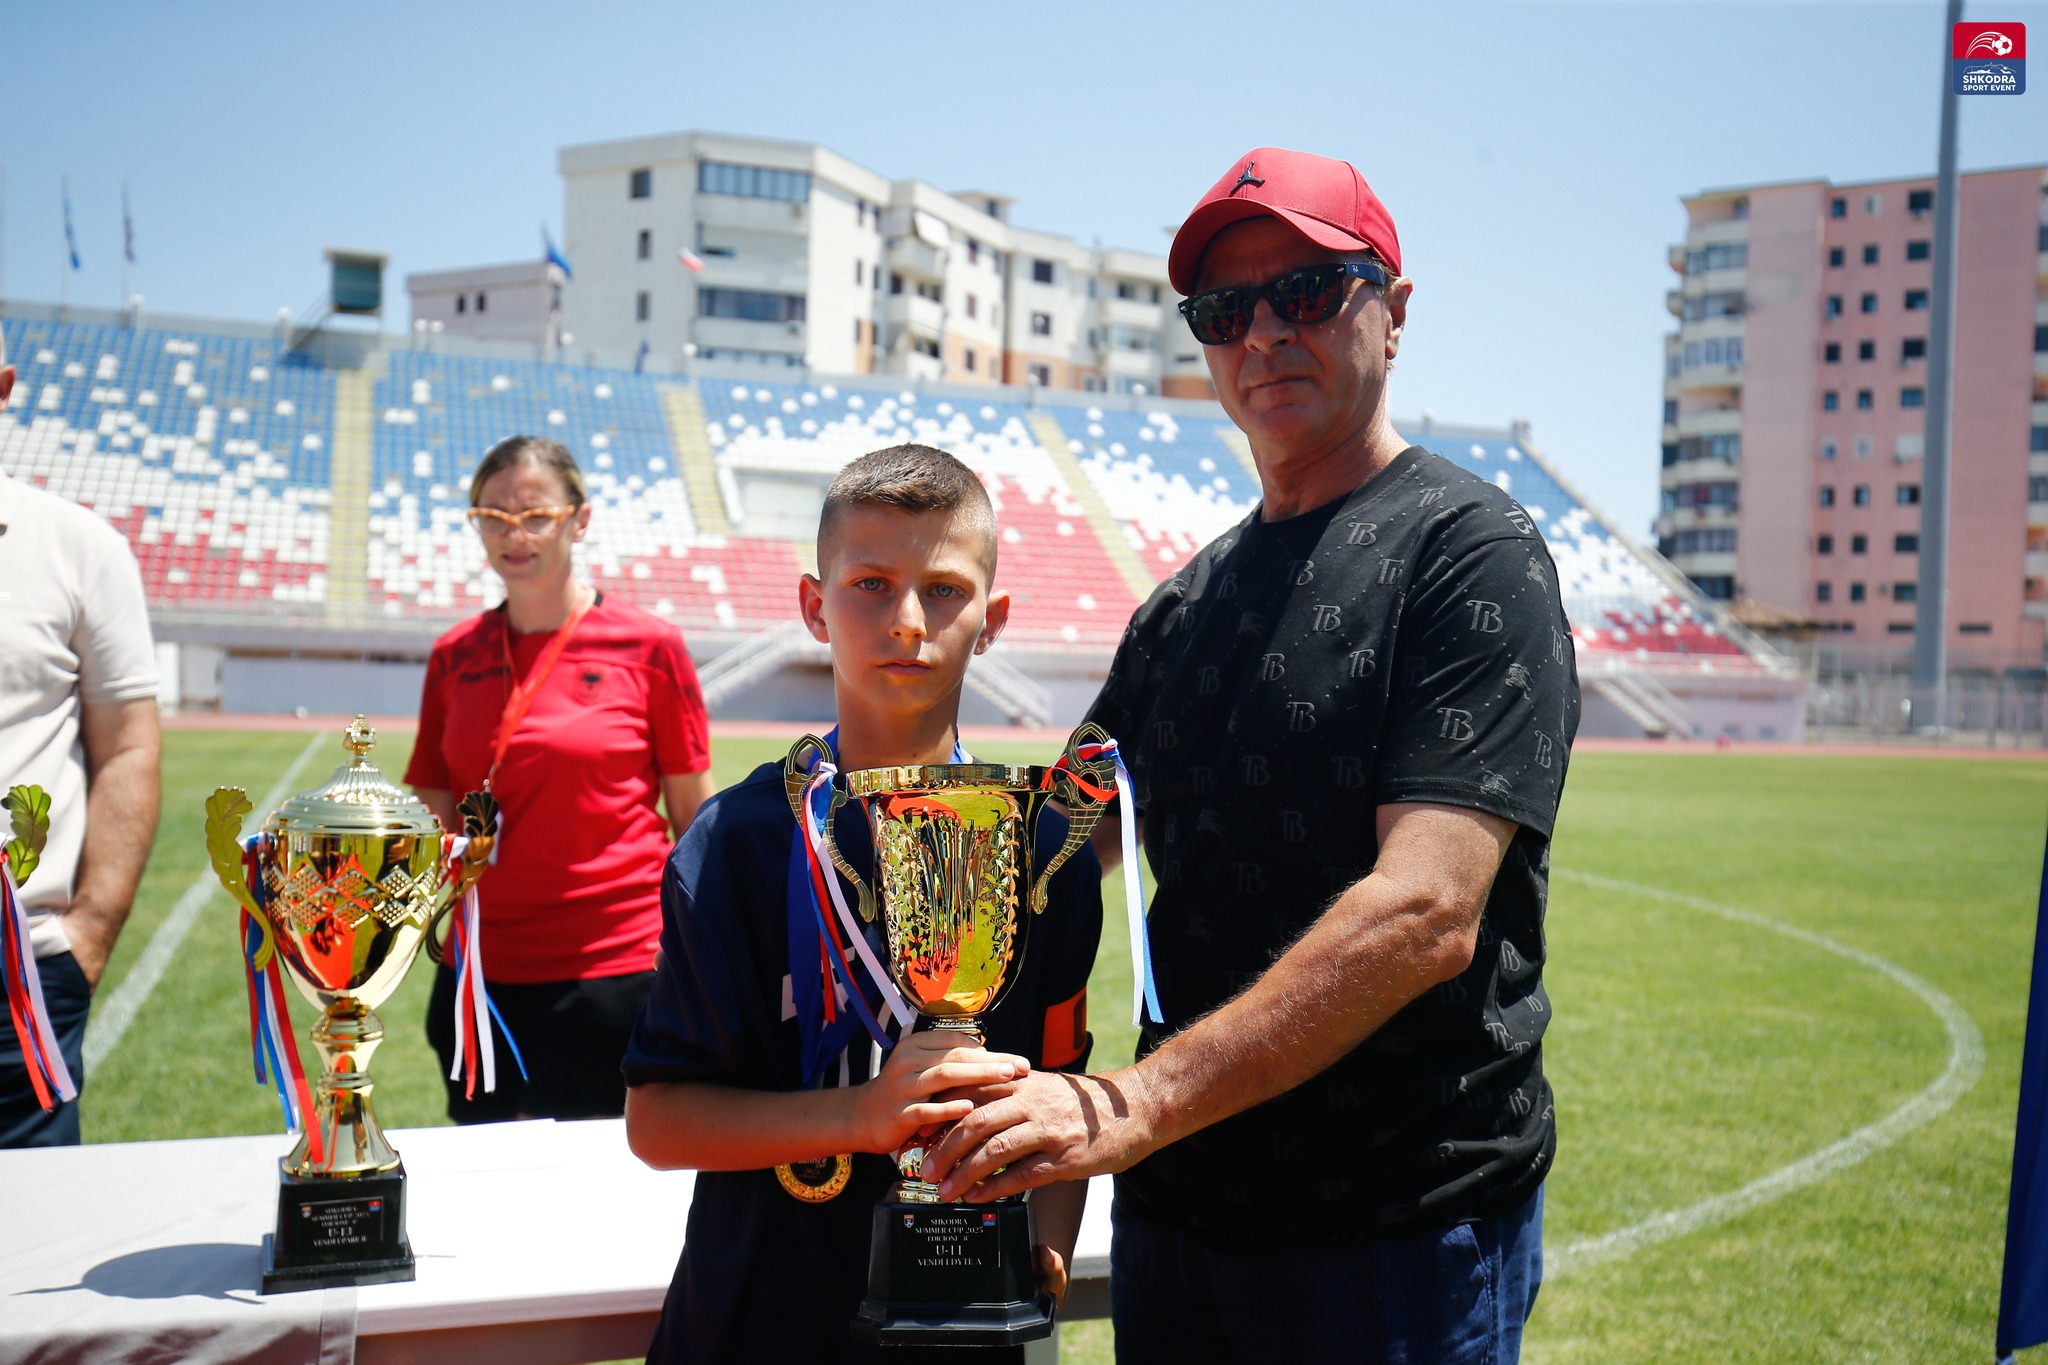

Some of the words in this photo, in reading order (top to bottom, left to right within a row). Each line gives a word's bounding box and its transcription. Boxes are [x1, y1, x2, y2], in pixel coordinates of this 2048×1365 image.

[1346, 521, 1377, 547] TB
[1504, 503, 1534, 536] TB
[1286, 559, 1314, 587] TB
[1311, 604, 1341, 633] TB
[1466, 599, 1504, 635] TB
[1259, 652, 1286, 681] TB
[1348, 648, 1377, 679] TB
[1286, 701, 1317, 734] TB
[1437, 706, 1475, 742] TB
[1242, 755, 1272, 788] TB
[930, 1218, 968, 1226] SHKODRA
[936, 1245, 962, 1256] U-11
[975, 1258, 982, 1266] A
